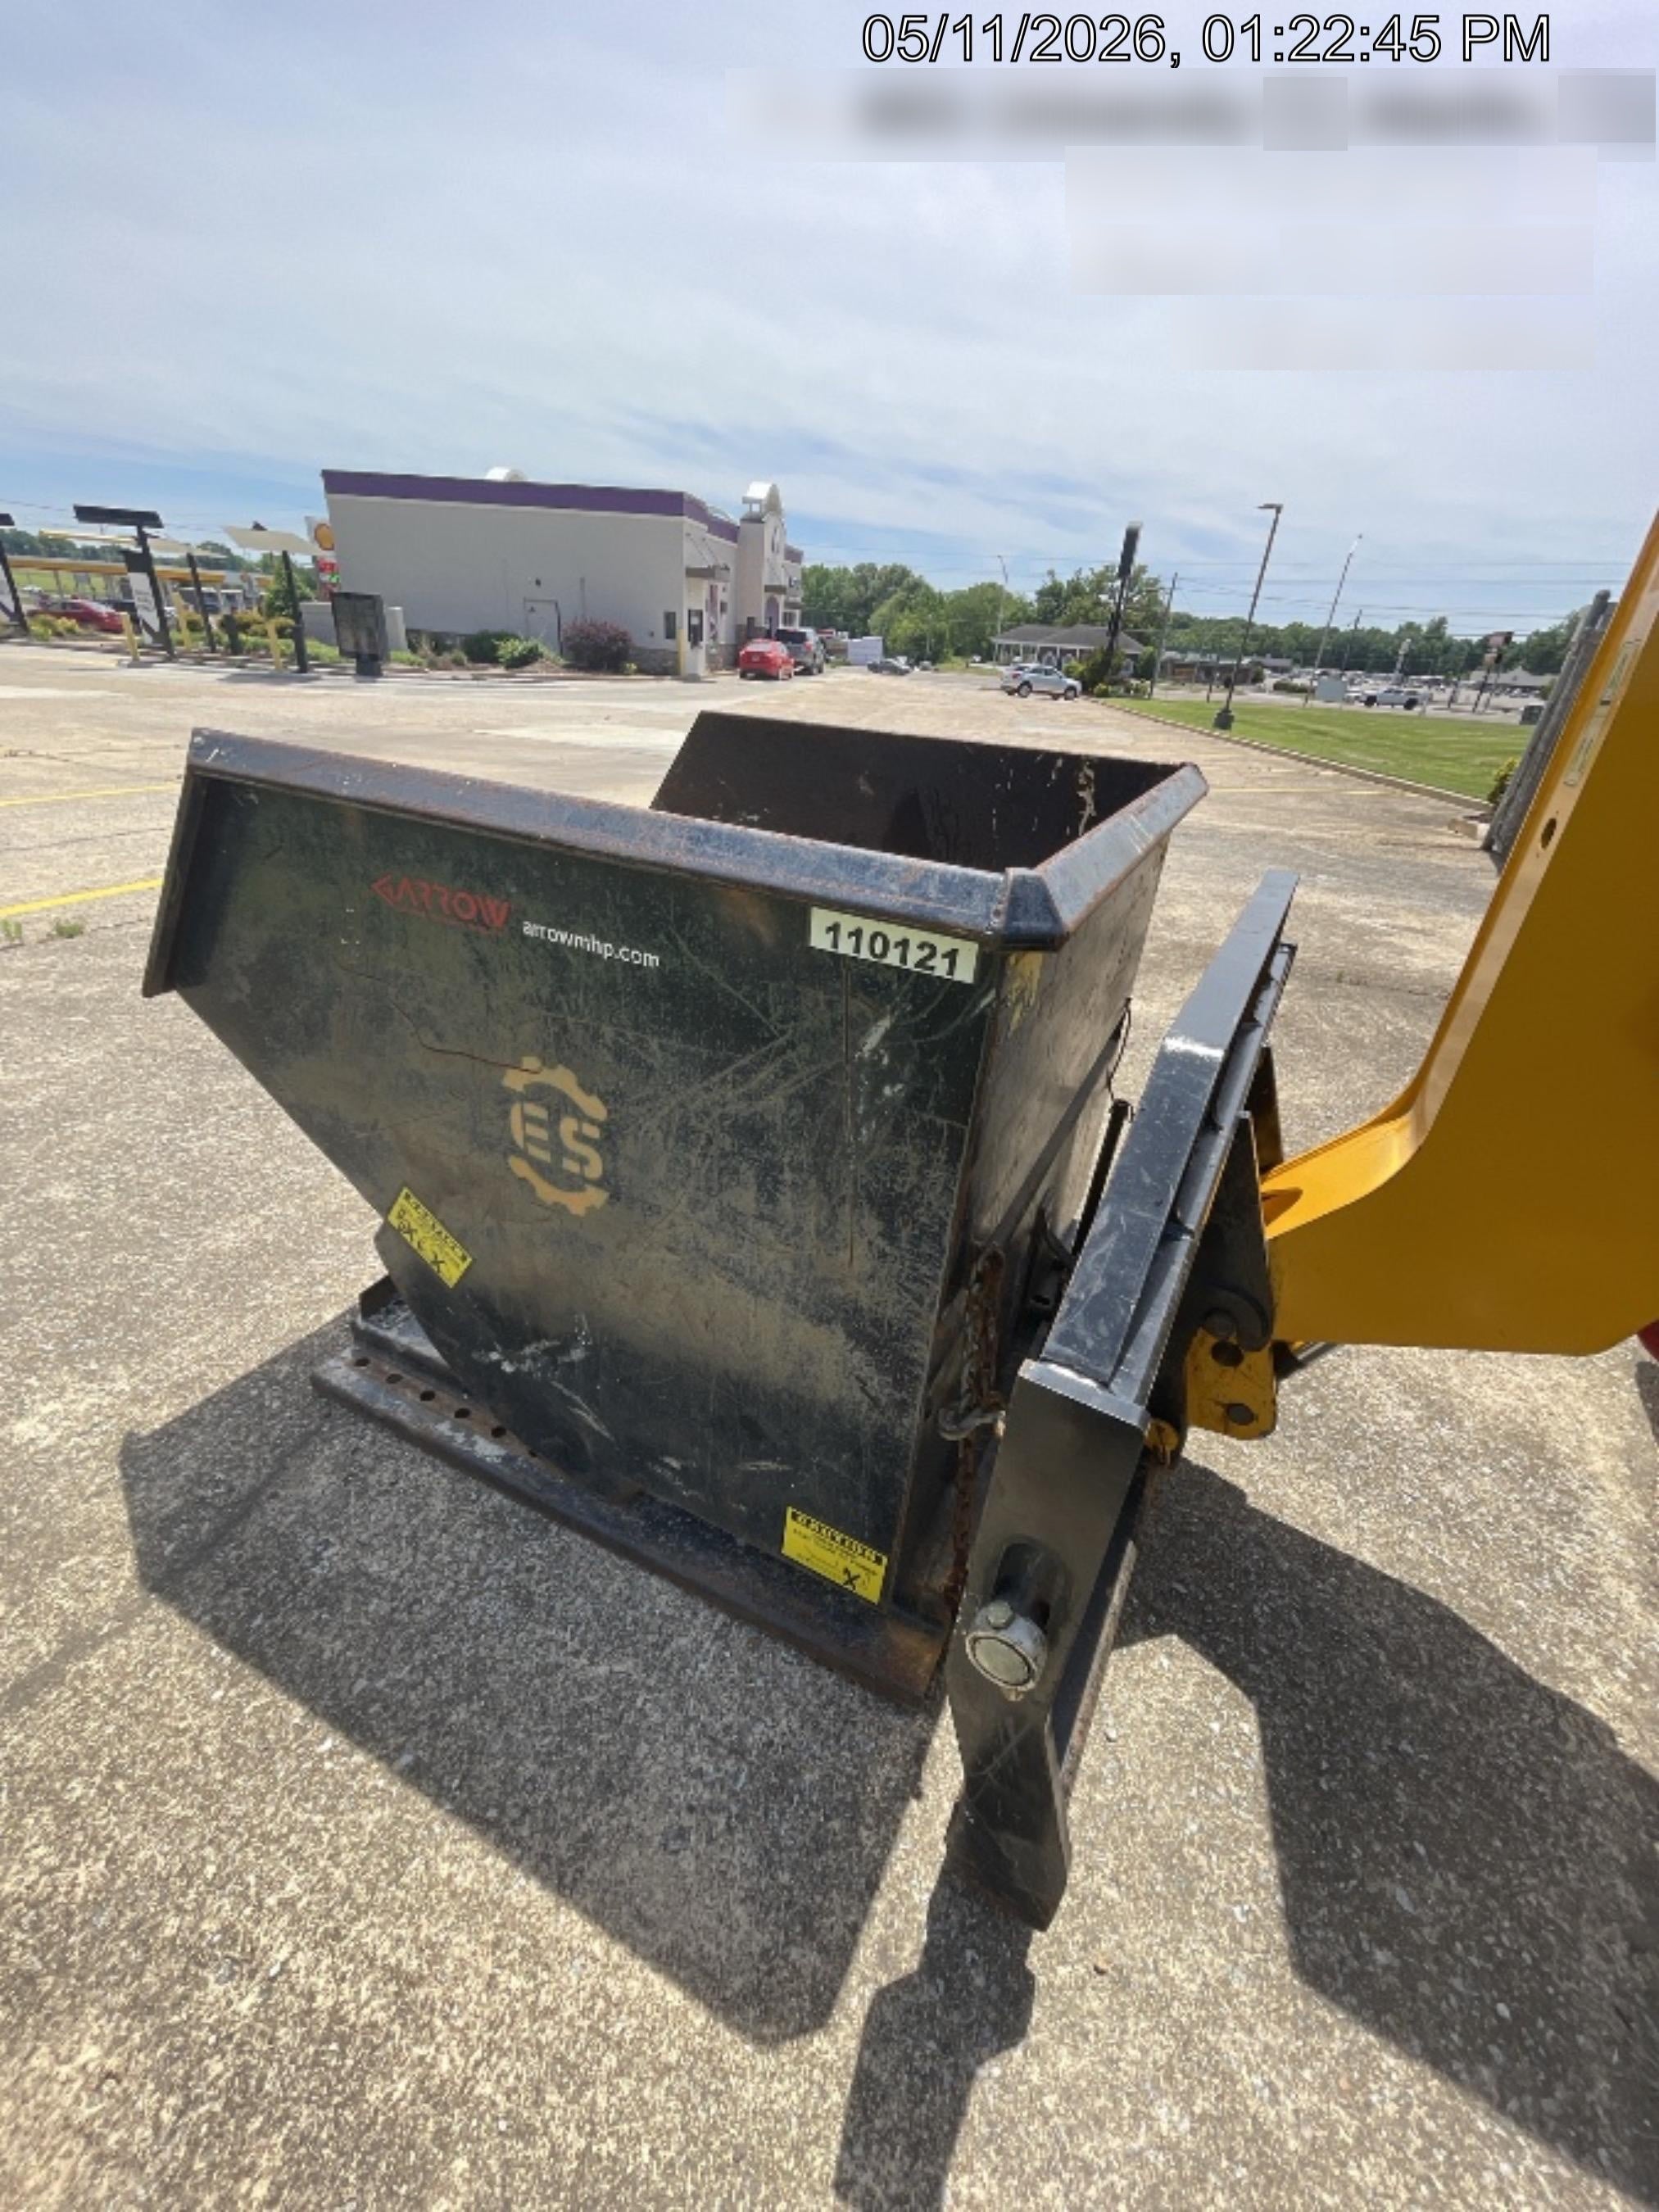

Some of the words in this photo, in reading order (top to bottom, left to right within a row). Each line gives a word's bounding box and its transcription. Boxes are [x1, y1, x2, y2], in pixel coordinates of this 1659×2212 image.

[522, 921, 660, 968] arrowmhp.com
[825, 921, 959, 976] 110121
[510, 1101, 603, 1180] ES
